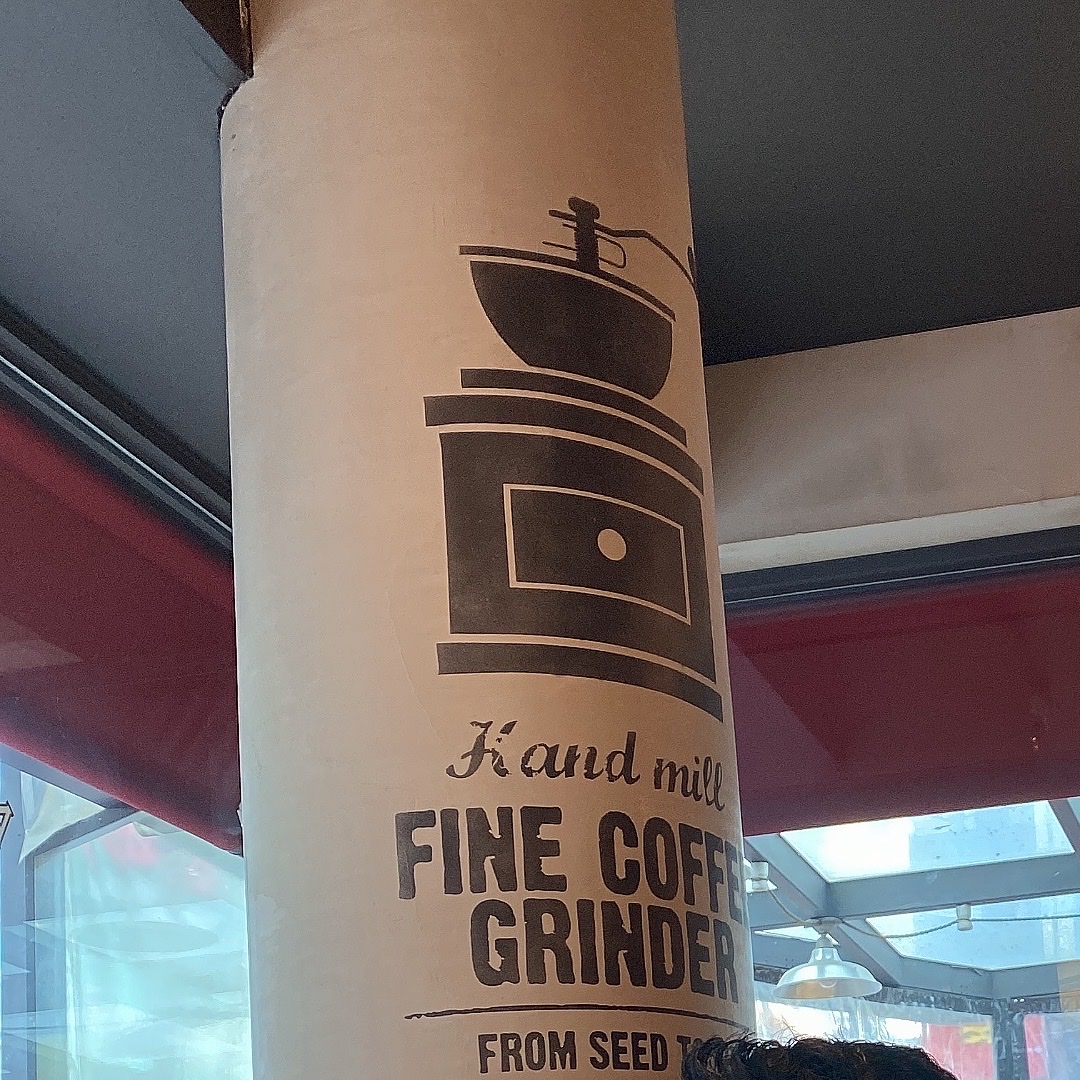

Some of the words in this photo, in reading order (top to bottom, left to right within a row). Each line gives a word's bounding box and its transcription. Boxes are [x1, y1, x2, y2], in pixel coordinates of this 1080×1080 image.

[654, 755, 725, 812] mill
[395, 805, 568, 899] FINE
[598, 810, 746, 926] COFFE
[470, 898, 740, 1003] GRINDER
[478, 1030, 577, 1074] FROM
[588, 1030, 669, 1073] SEED
